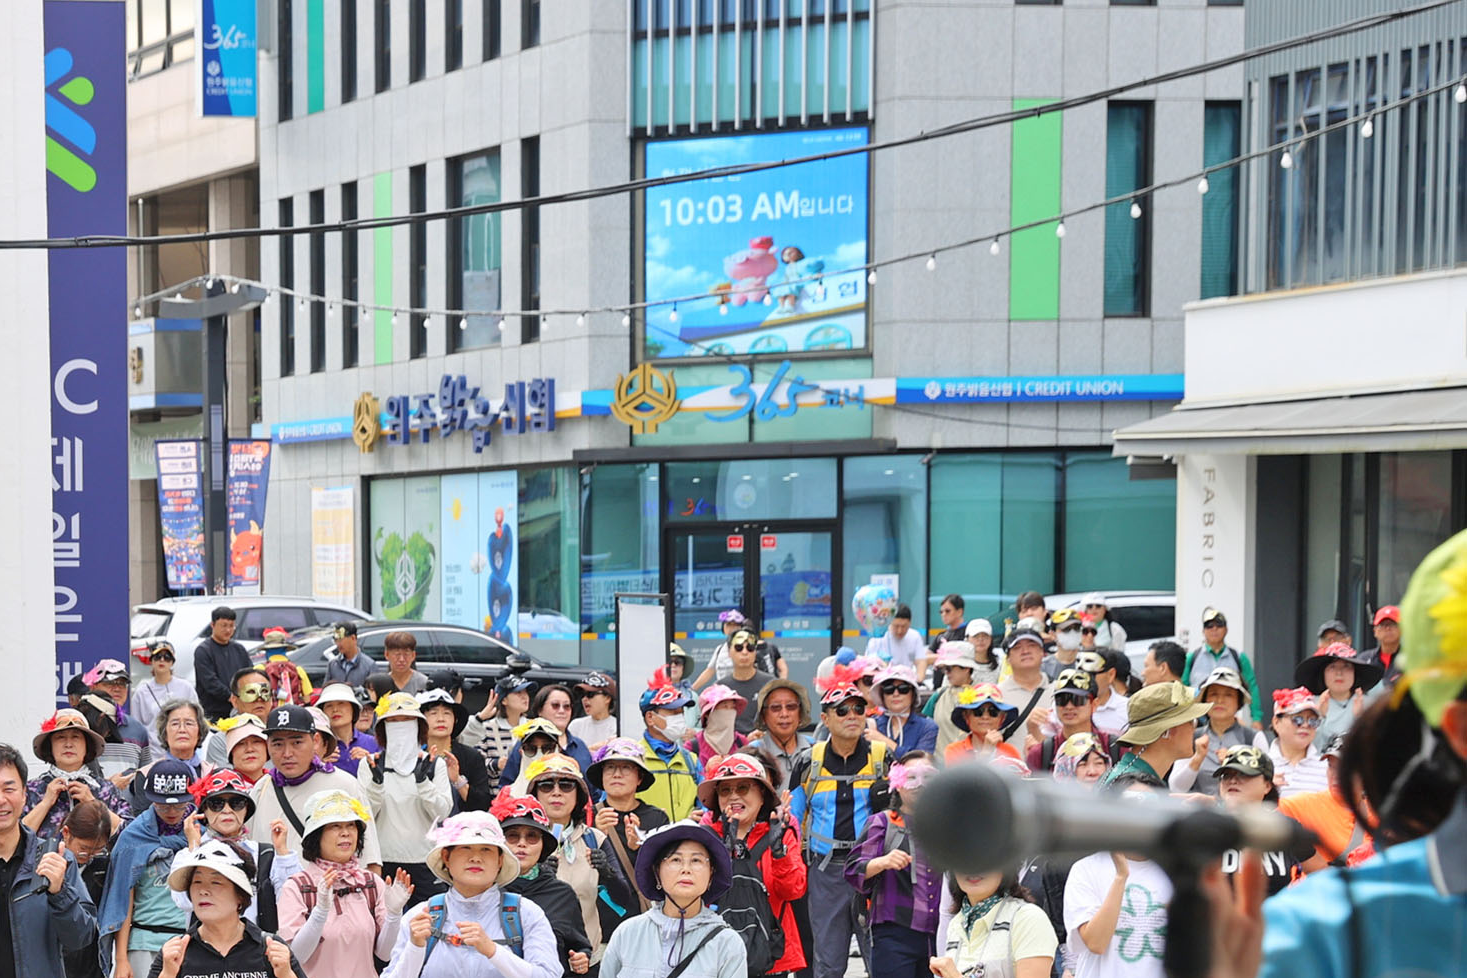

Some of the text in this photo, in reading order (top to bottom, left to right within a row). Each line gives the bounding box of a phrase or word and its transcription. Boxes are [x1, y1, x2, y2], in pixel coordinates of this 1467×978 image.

[659, 194, 743, 227] 10:03
[704, 360, 819, 422] 365
[1024, 380, 1072, 396] CREDIT
[1075, 380, 1124, 396] UNION
[1201, 468, 1216, 589] FABRIC
[1221, 848, 1286, 876] DNY
